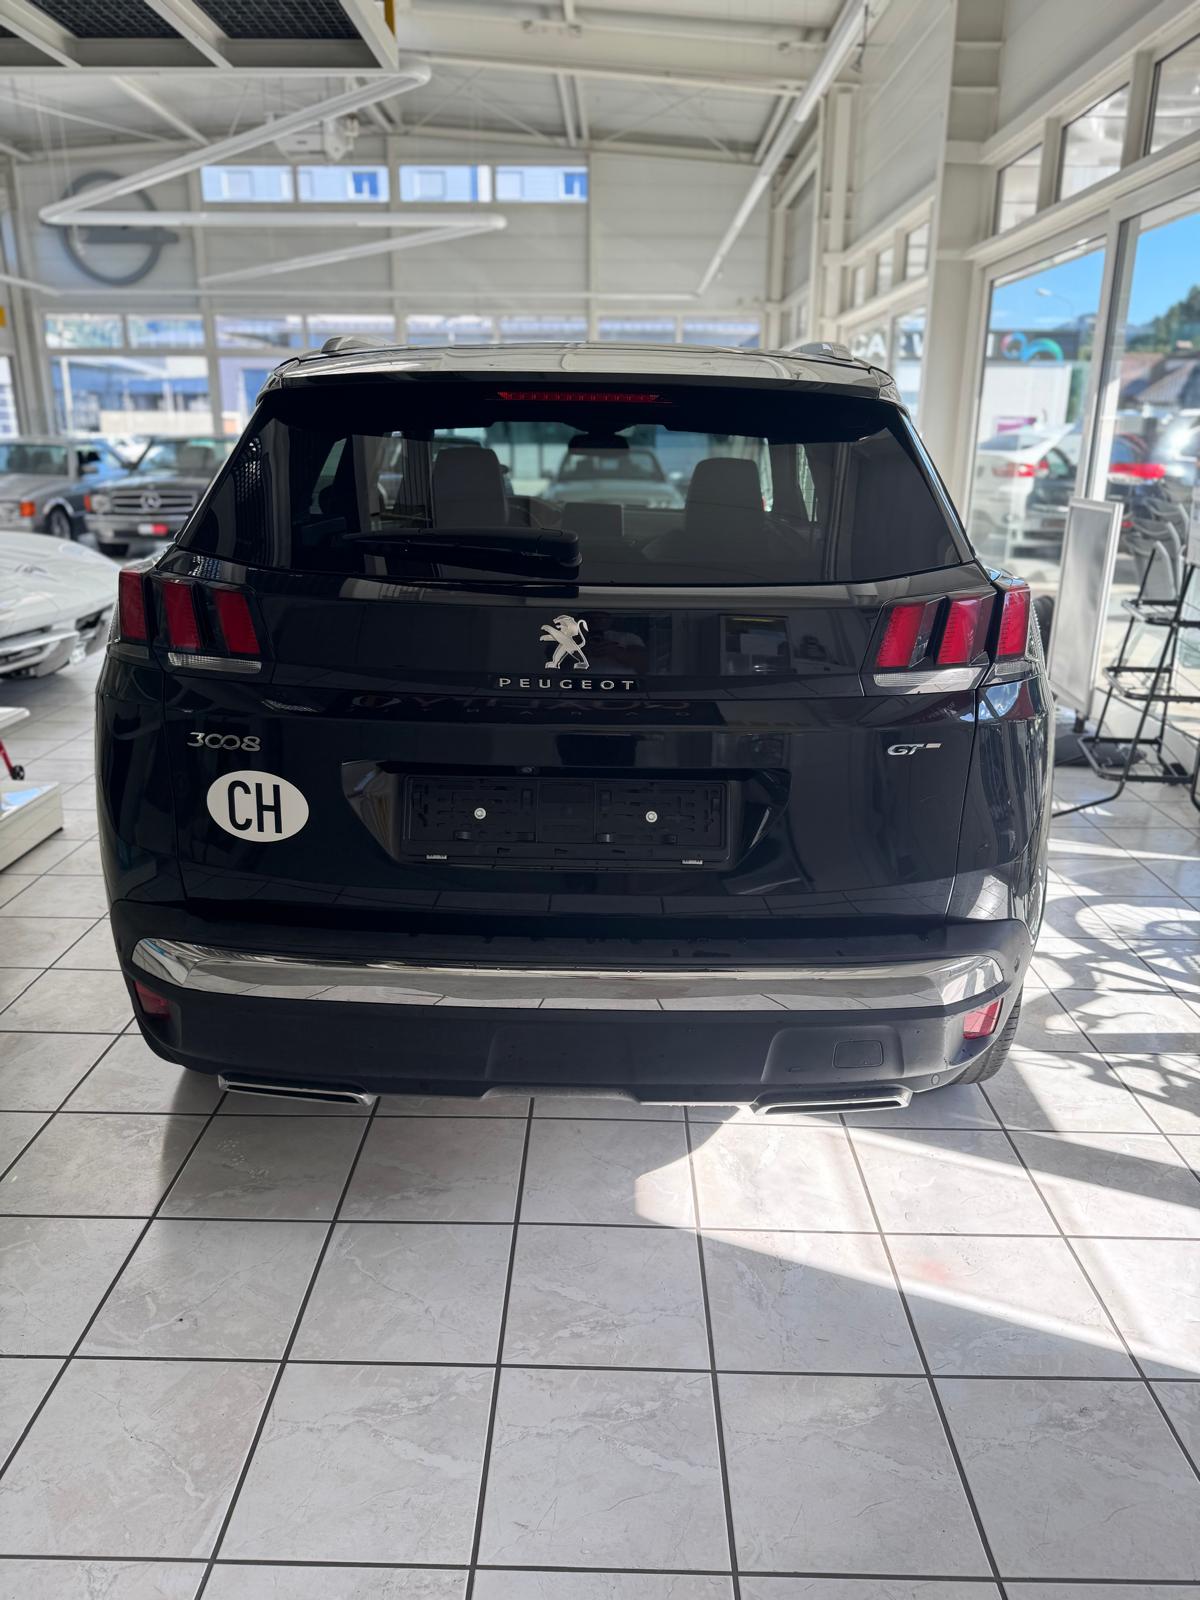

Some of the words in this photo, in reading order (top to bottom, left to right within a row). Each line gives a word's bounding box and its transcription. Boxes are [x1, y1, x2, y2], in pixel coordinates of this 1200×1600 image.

[499, 677, 635, 691] PEUGEOT
[186, 731, 262, 752] 3008
[887, 743, 925, 756] GT
[227, 779, 283, 834] CH
